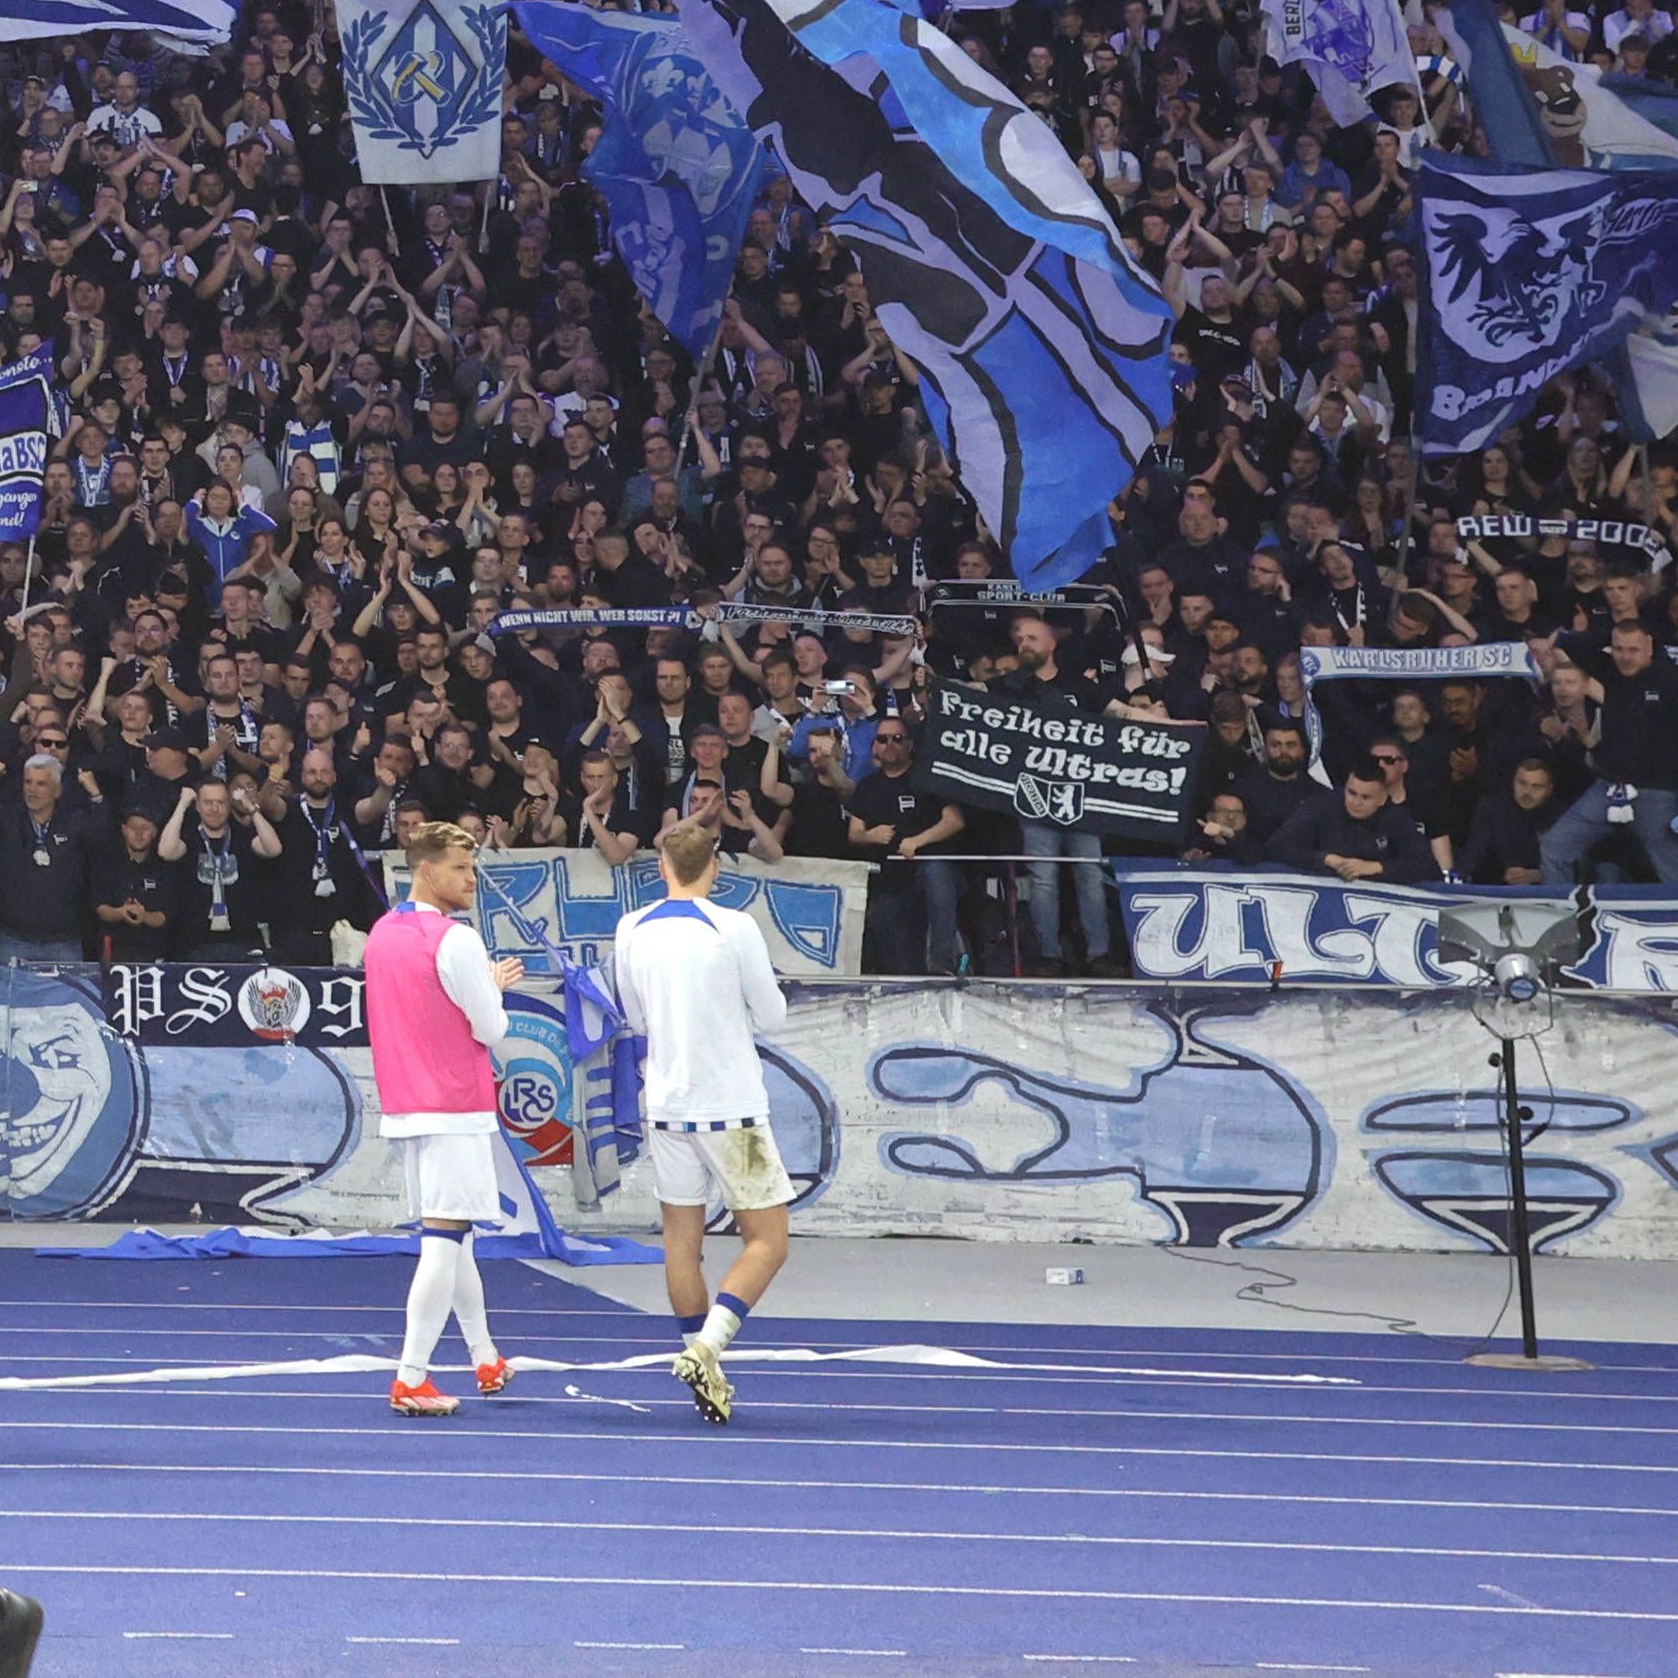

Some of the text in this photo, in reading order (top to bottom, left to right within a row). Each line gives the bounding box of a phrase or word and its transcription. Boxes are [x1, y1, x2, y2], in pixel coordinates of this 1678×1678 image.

[1331, 644, 1512, 669] KARLSRUHER SC
[939, 688, 1192, 760] Freiheit für
[939, 729, 1013, 765] alle
[515, 1021, 546, 1039] CLUB
